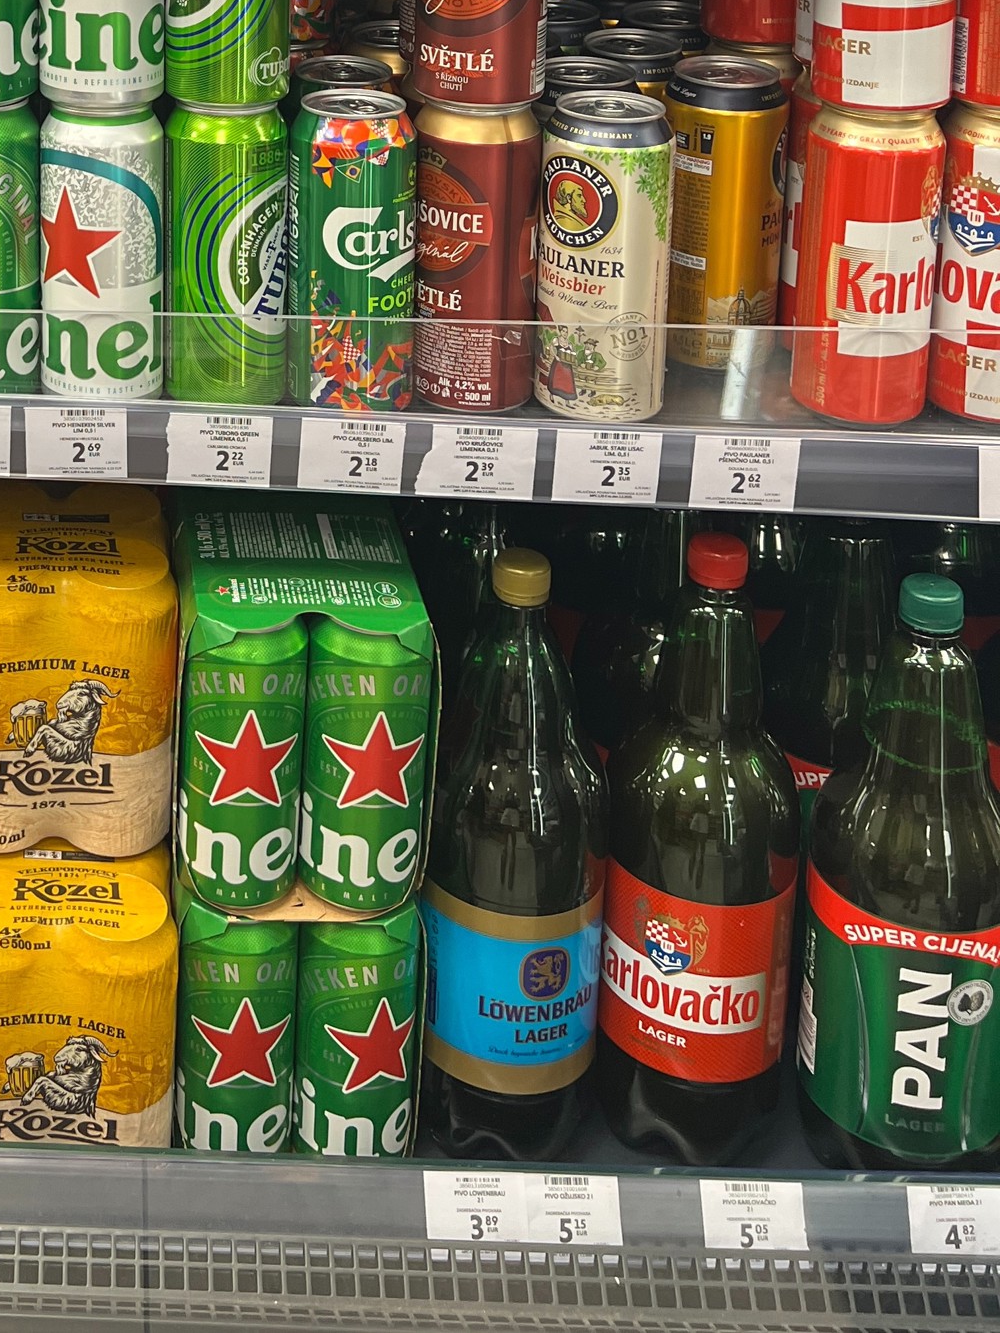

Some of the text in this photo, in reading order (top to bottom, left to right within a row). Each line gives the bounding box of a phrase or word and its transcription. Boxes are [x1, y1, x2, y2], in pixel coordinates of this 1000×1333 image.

[421, 41, 494, 72] SVĚTLÉ
[544, 161, 613, 198] PAULANER
[544, 214, 605, 243] MÜNCHEN
[541, 267, 607, 296] Weissbier
[731, 473, 761, 493] 2 62
[82, 661, 130, 680] LAGER
[31, 801, 66, 810] 1874
[12, 878, 124, 905] Kozel
[843, 923, 1000, 965] SUPER CIJENA!
[478, 984, 592, 1024] LÖWENBRÄU
[78, 1017, 126, 1039] LAGER
[515, 1023, 568, 1044] LAGER
[638, 1019, 687, 1048] LAGER
[891, 967, 953, 1110] PAN
[471, 1215, 498, 1240] 3 89
[559, 1219, 586, 1243] 5 15
[741, 1224, 768, 1248] 5 05
[945, 1225, 975, 1249] 4 82
